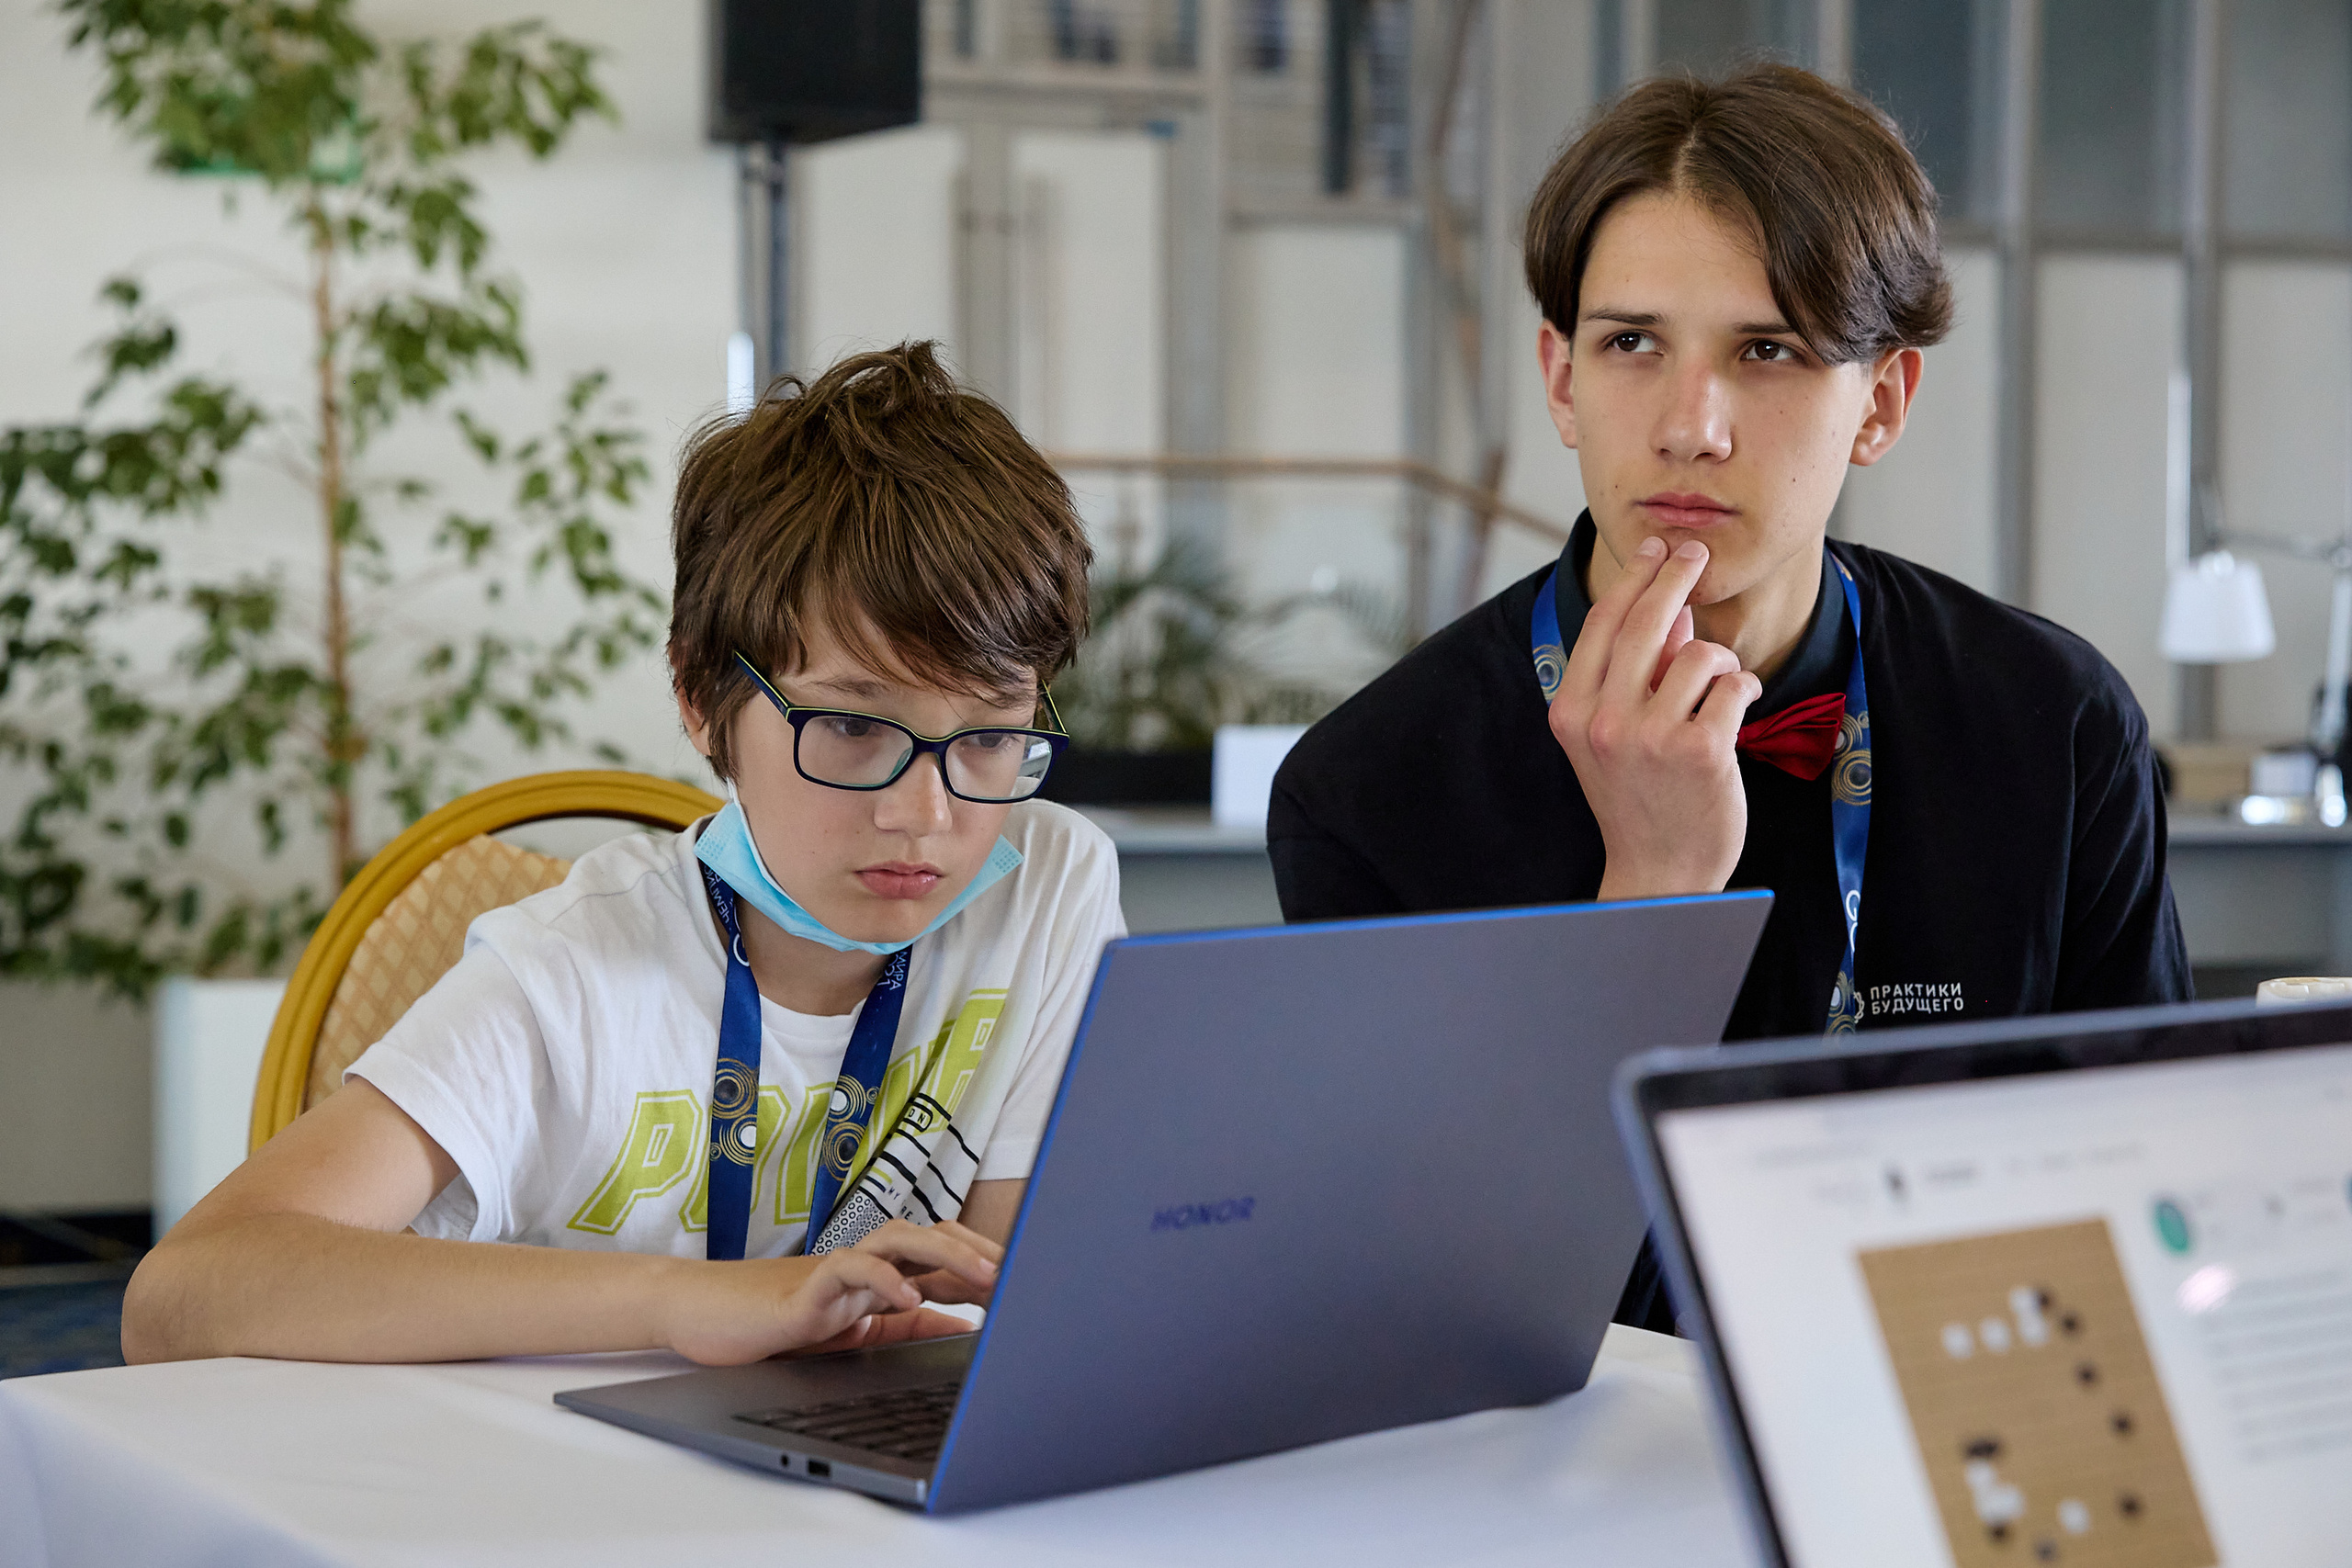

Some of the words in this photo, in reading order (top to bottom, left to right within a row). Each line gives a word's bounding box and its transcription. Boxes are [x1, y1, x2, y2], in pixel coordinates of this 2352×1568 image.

[889, 951, 909, 991] МИРА
[1870, 982, 1962, 1000] ПРАКТИКИ
[1871, 997, 1964, 1015] БУДУЩЕГО
